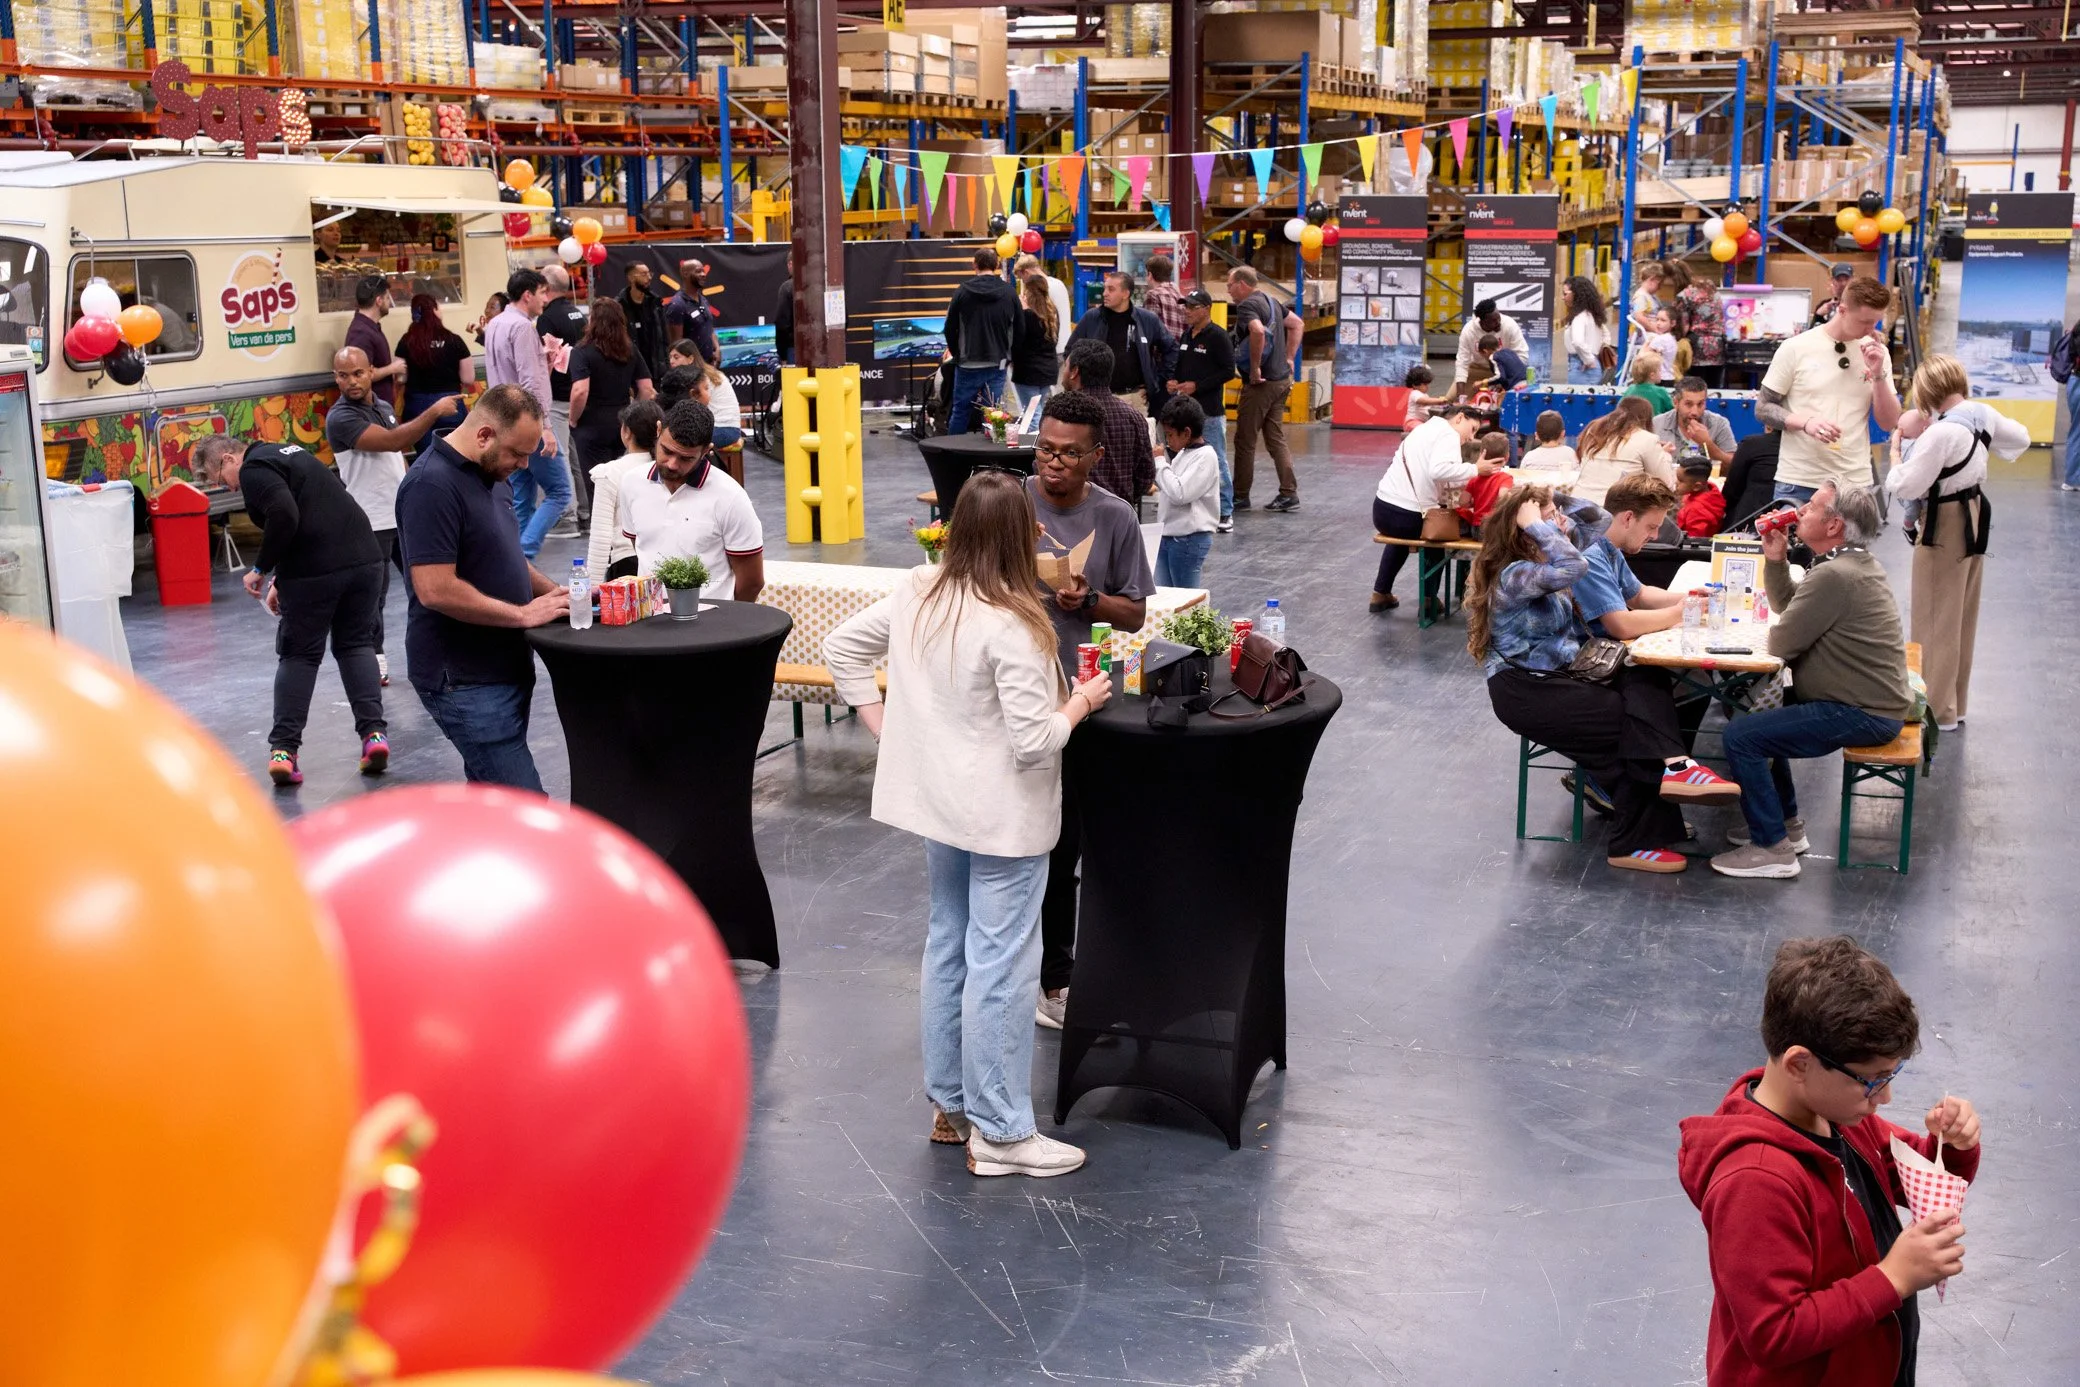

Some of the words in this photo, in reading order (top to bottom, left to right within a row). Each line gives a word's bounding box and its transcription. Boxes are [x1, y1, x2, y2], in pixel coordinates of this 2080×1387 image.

[152, 60, 312, 160] Saps
[221, 282, 296, 324] Saps
[231, 335, 249, 346] Vers
[249, 335, 263, 344] van
[264, 333, 274, 342] de
[275, 333, 293, 344] pers
[860, 369, 883, 379] ANCE
